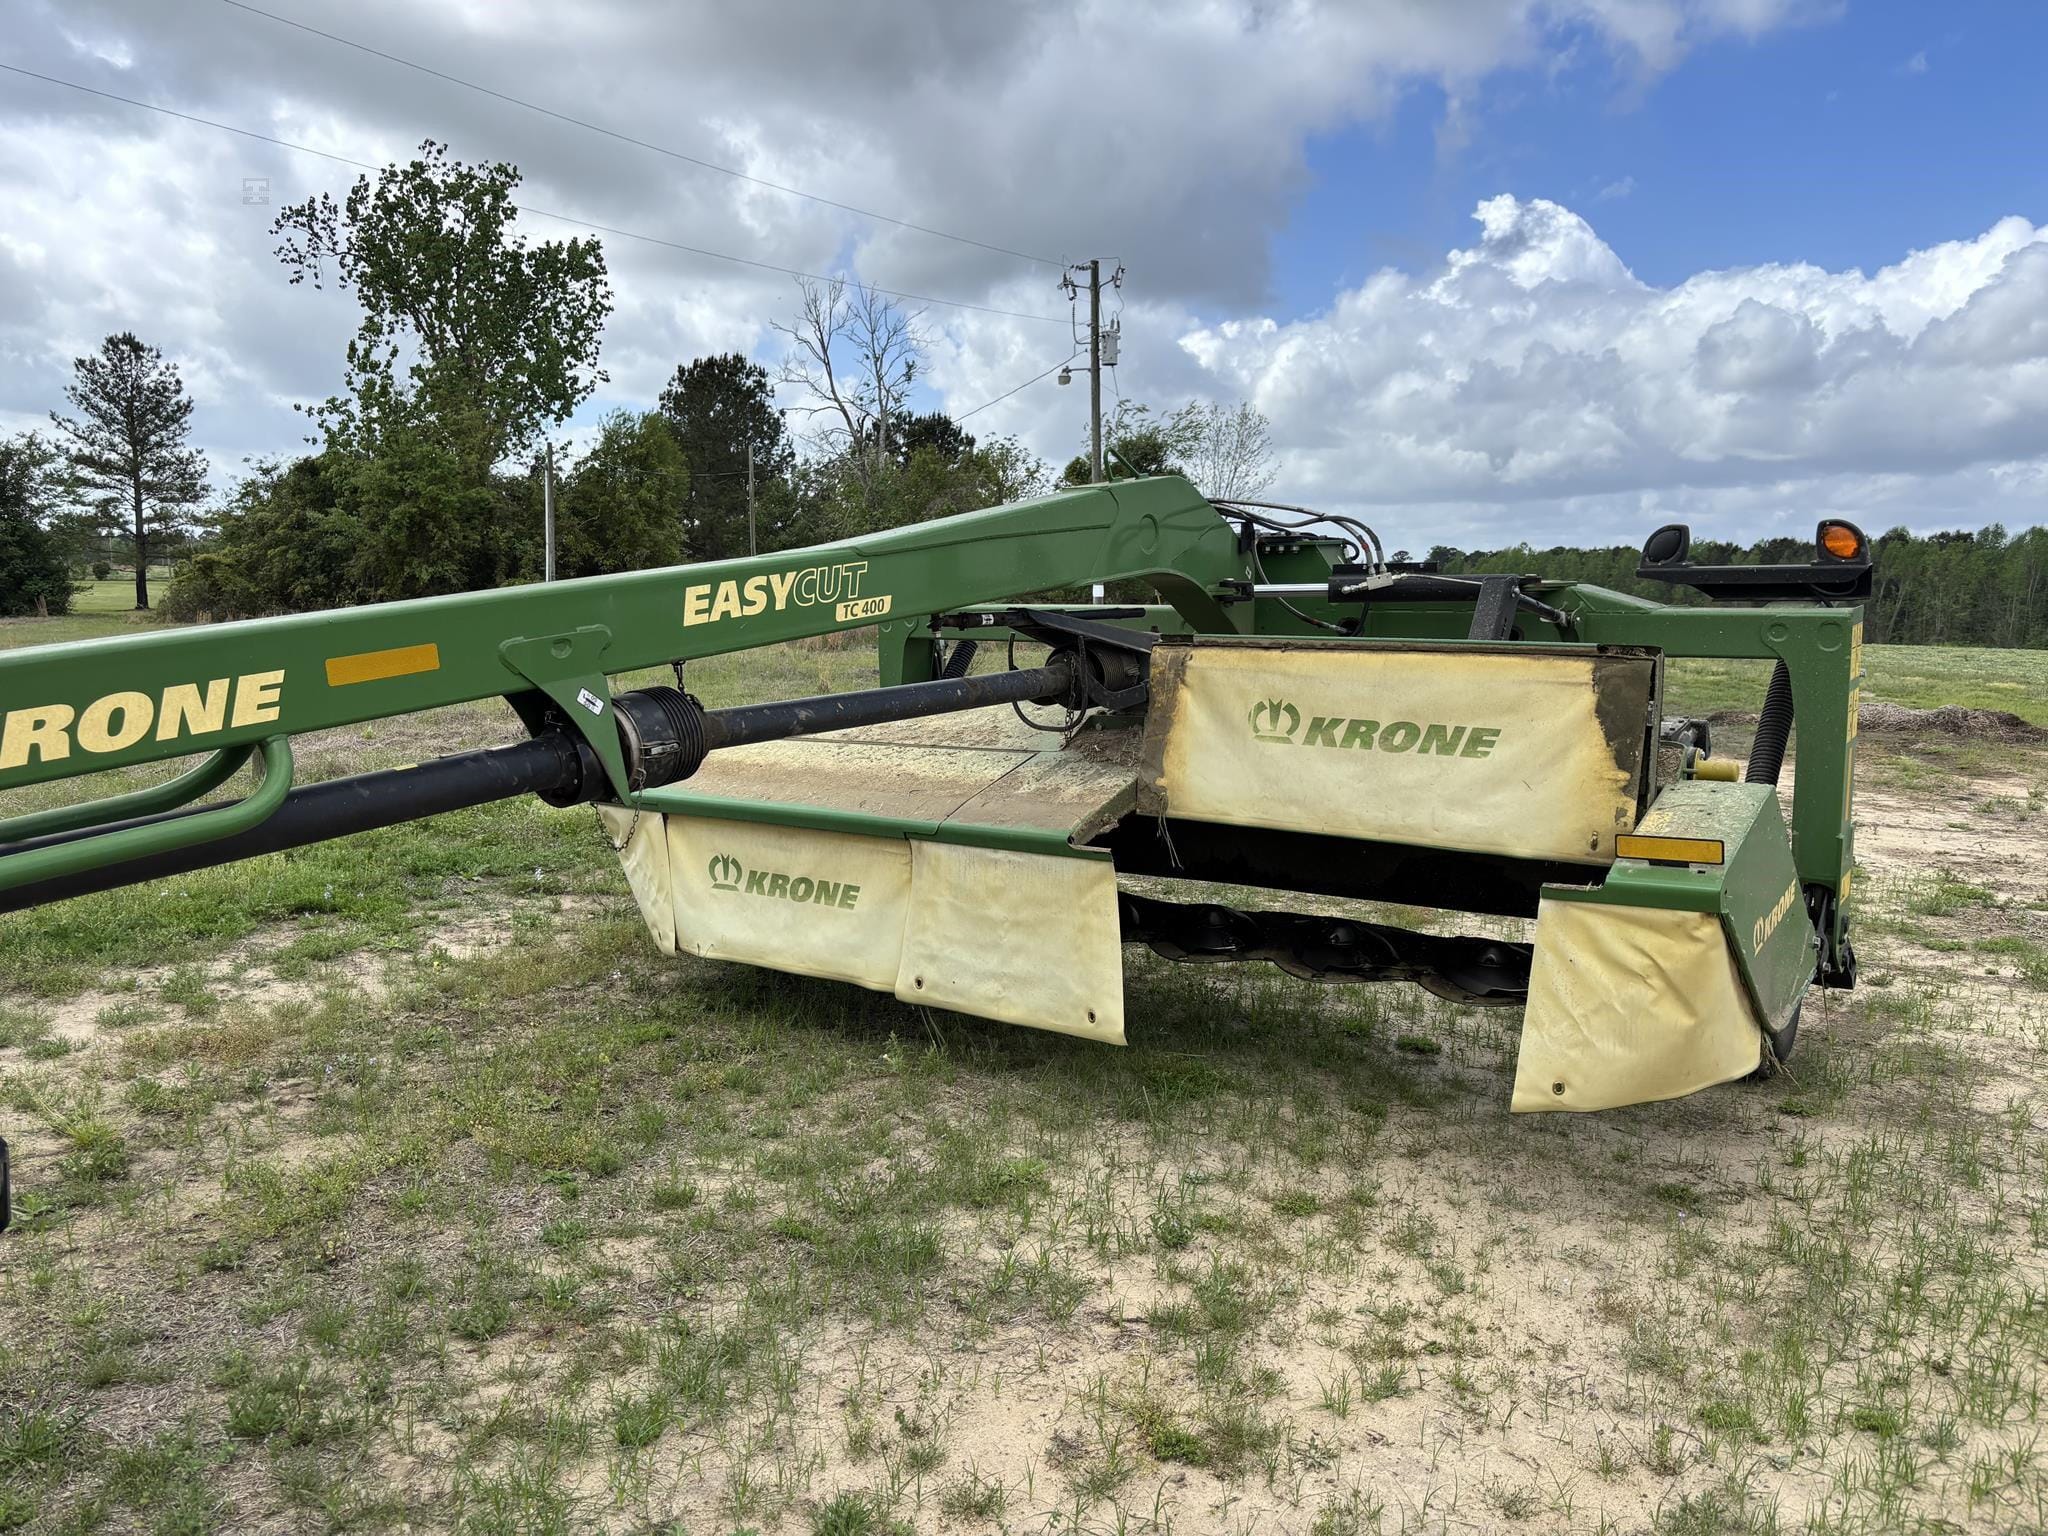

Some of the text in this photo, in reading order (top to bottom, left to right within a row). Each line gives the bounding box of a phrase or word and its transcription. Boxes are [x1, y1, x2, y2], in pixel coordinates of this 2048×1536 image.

[684, 561, 868, 626] EASYCUT
[843, 598, 884, 618] TC 400
[0, 669, 285, 769] RONE
[1302, 716, 1502, 759] KRONE
[745, 869, 861, 910] KRONE
[1764, 878, 1796, 942] KRONE
